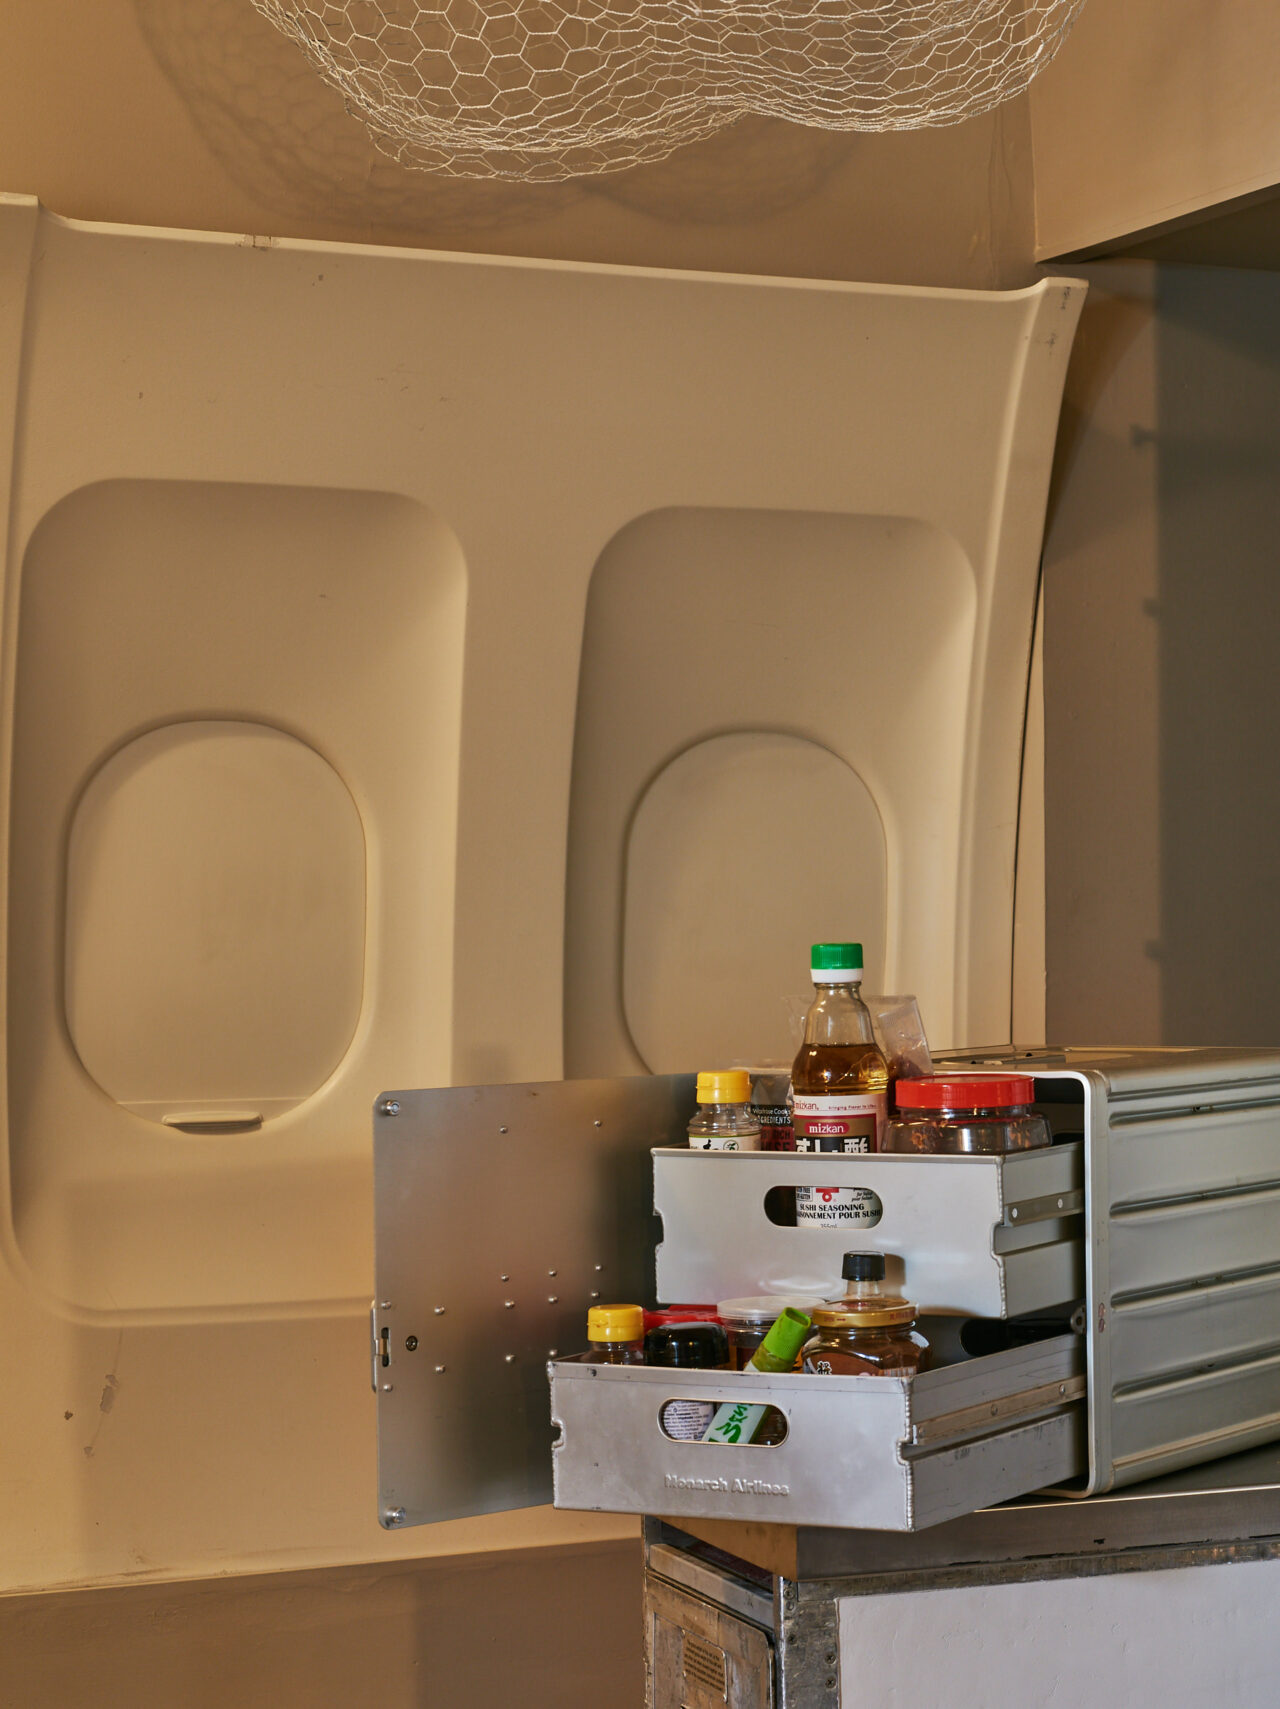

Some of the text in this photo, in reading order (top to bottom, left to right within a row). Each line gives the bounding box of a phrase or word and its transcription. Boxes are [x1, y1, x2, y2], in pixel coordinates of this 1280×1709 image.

[809, 1123, 845, 1134] mizkan
[800, 1203, 865, 1212] SUSHI SEASONING
[838, 1211, 860, 1220] POUR
[664, 1473, 790, 1497] Monarch Airlines
